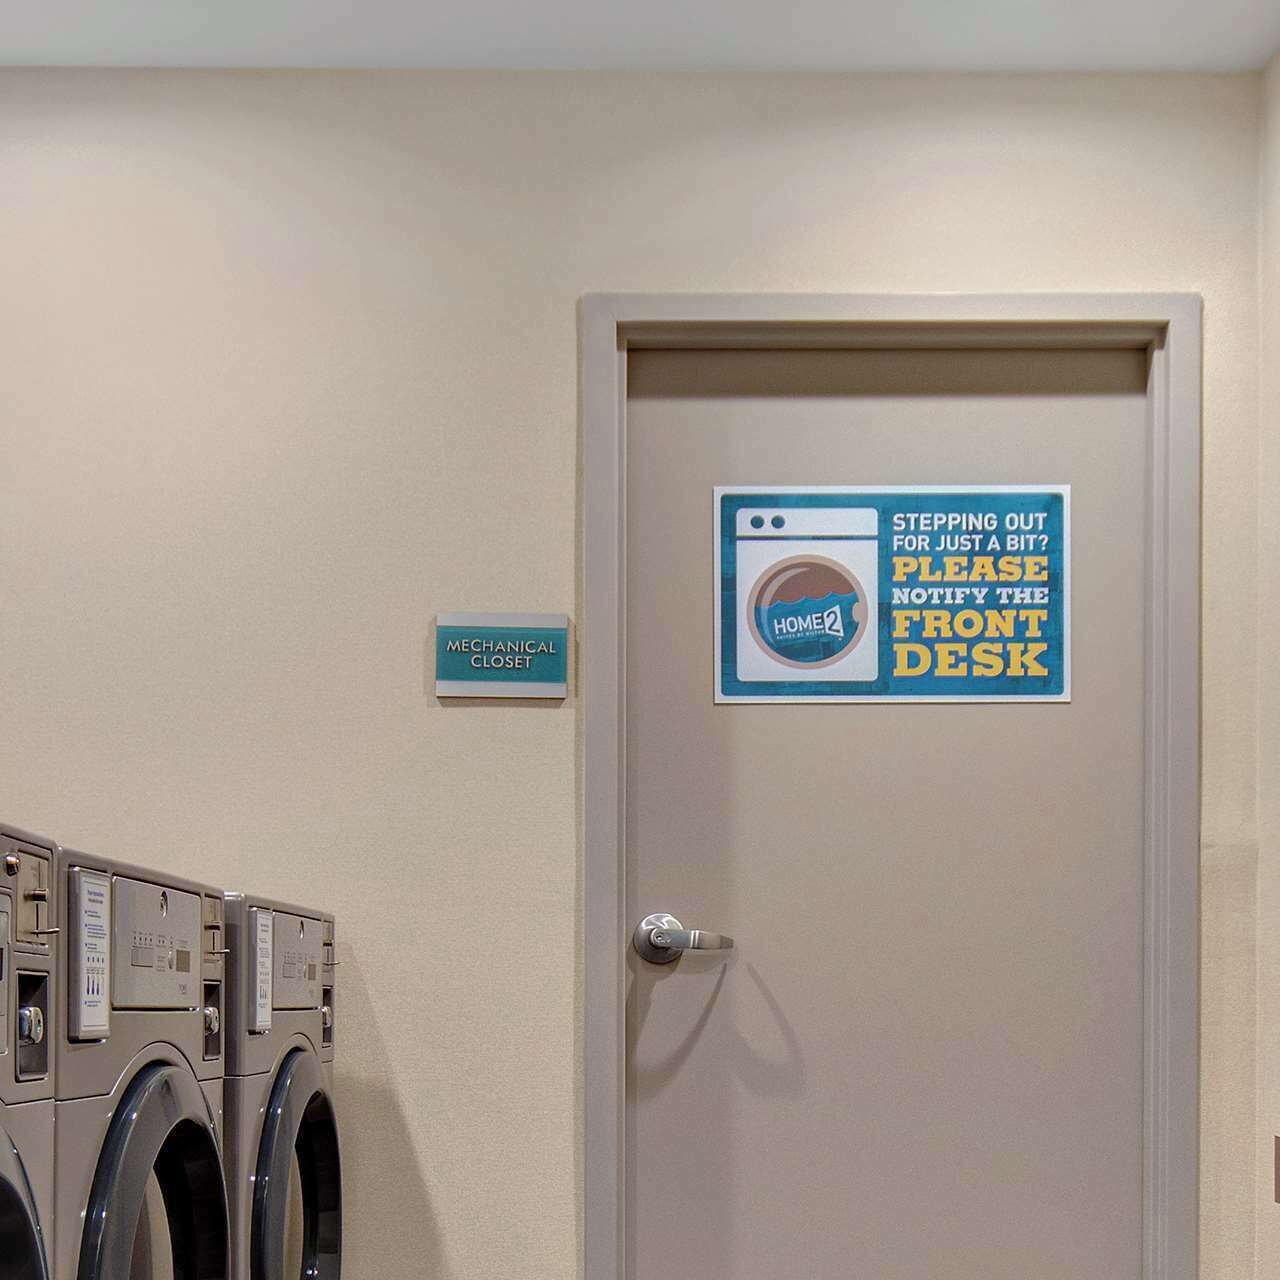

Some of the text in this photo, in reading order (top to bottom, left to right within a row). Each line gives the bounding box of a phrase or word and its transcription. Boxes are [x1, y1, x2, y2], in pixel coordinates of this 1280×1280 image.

[893, 513, 1048, 531] STEPPING OUT
[893, 534, 1048, 551] FOR JUST A BIT?
[892, 556, 1048, 582] PLEASE
[892, 587, 1048, 604] NOTIFY THE
[774, 606, 843, 636] HOME2
[892, 609, 1048, 638] FRONT
[447, 639, 556, 653] MECHANICAL
[471, 655, 532, 668] CLOSET
[893, 642, 1048, 677] DESK
